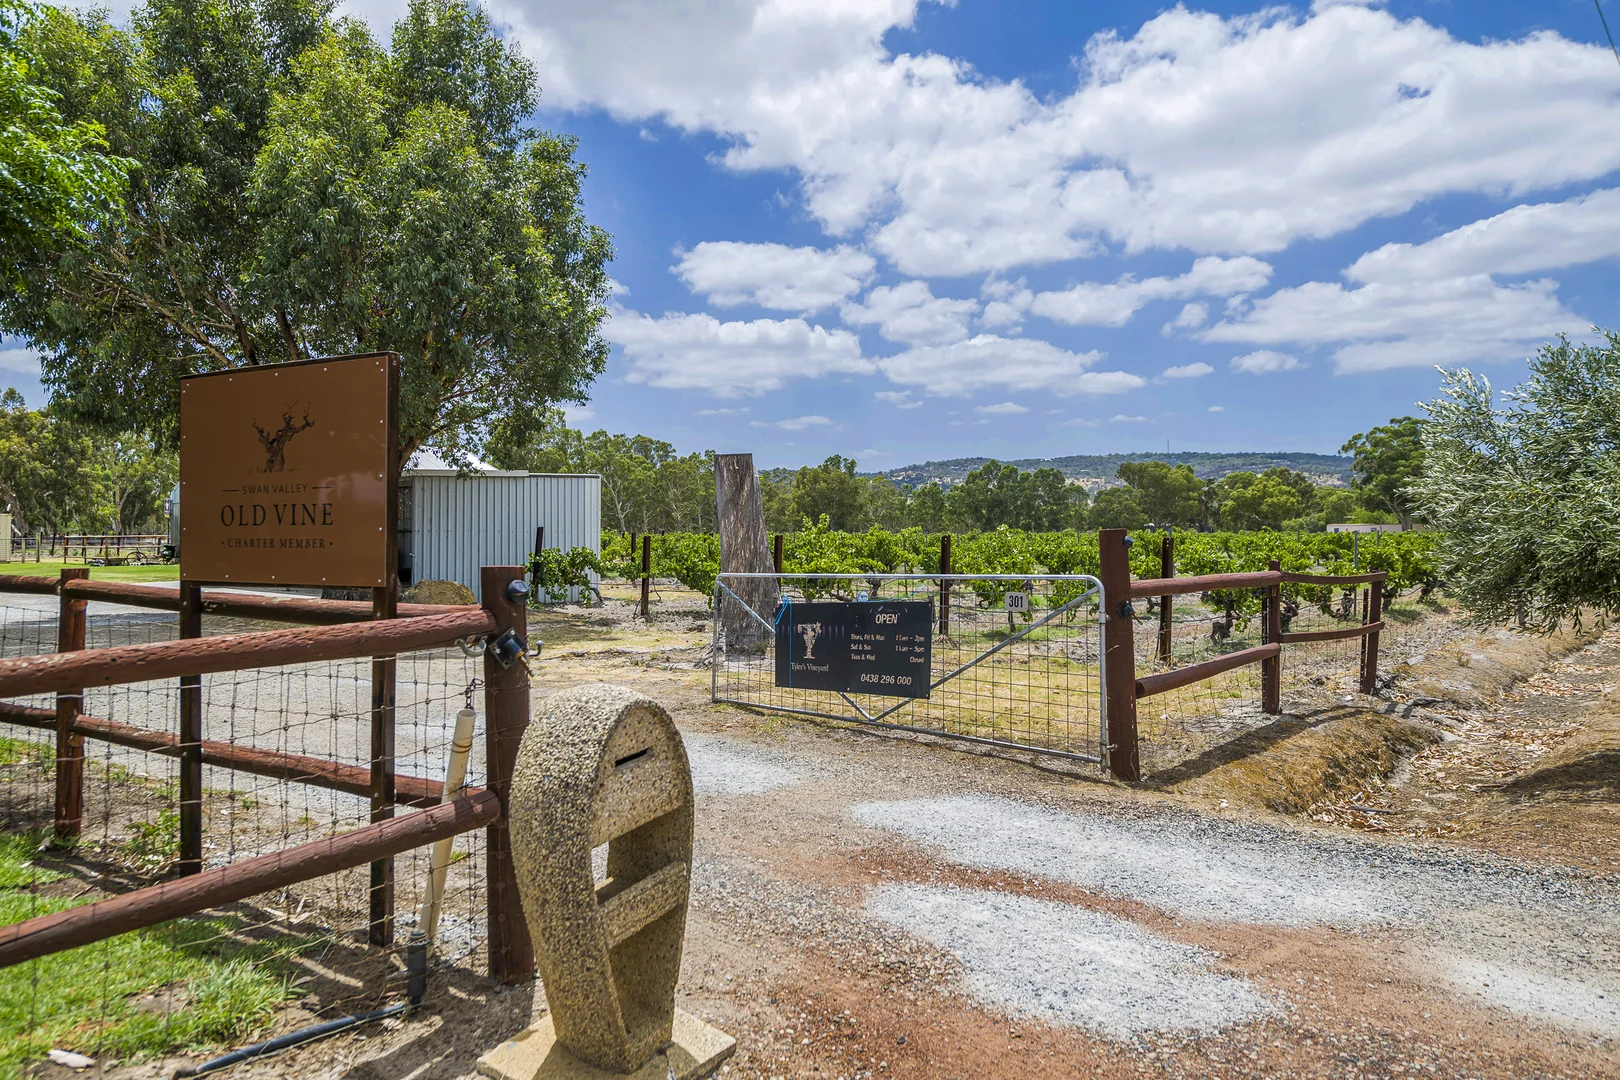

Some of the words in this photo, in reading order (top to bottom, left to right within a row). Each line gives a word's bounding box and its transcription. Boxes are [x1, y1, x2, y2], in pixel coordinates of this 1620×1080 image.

[242, 485, 269, 494] SWAN
[272, 483, 308, 493] VALLEY
[221, 504, 266, 527] OLD
[273, 503, 334, 526] VINE
[227, 538, 276, 548] CHARTER
[279, 539, 326, 549] MEMBER
[1009, 595, 1023, 608] 301
[875, 613, 898, 624] OPEN
[791, 662, 806, 671] Tyler's
[807, 663, 829, 673] Vineyard
[860, 673, 879, 683] 0438
[880, 675, 895, 684] 296
[896, 676, 912, 685] 000
